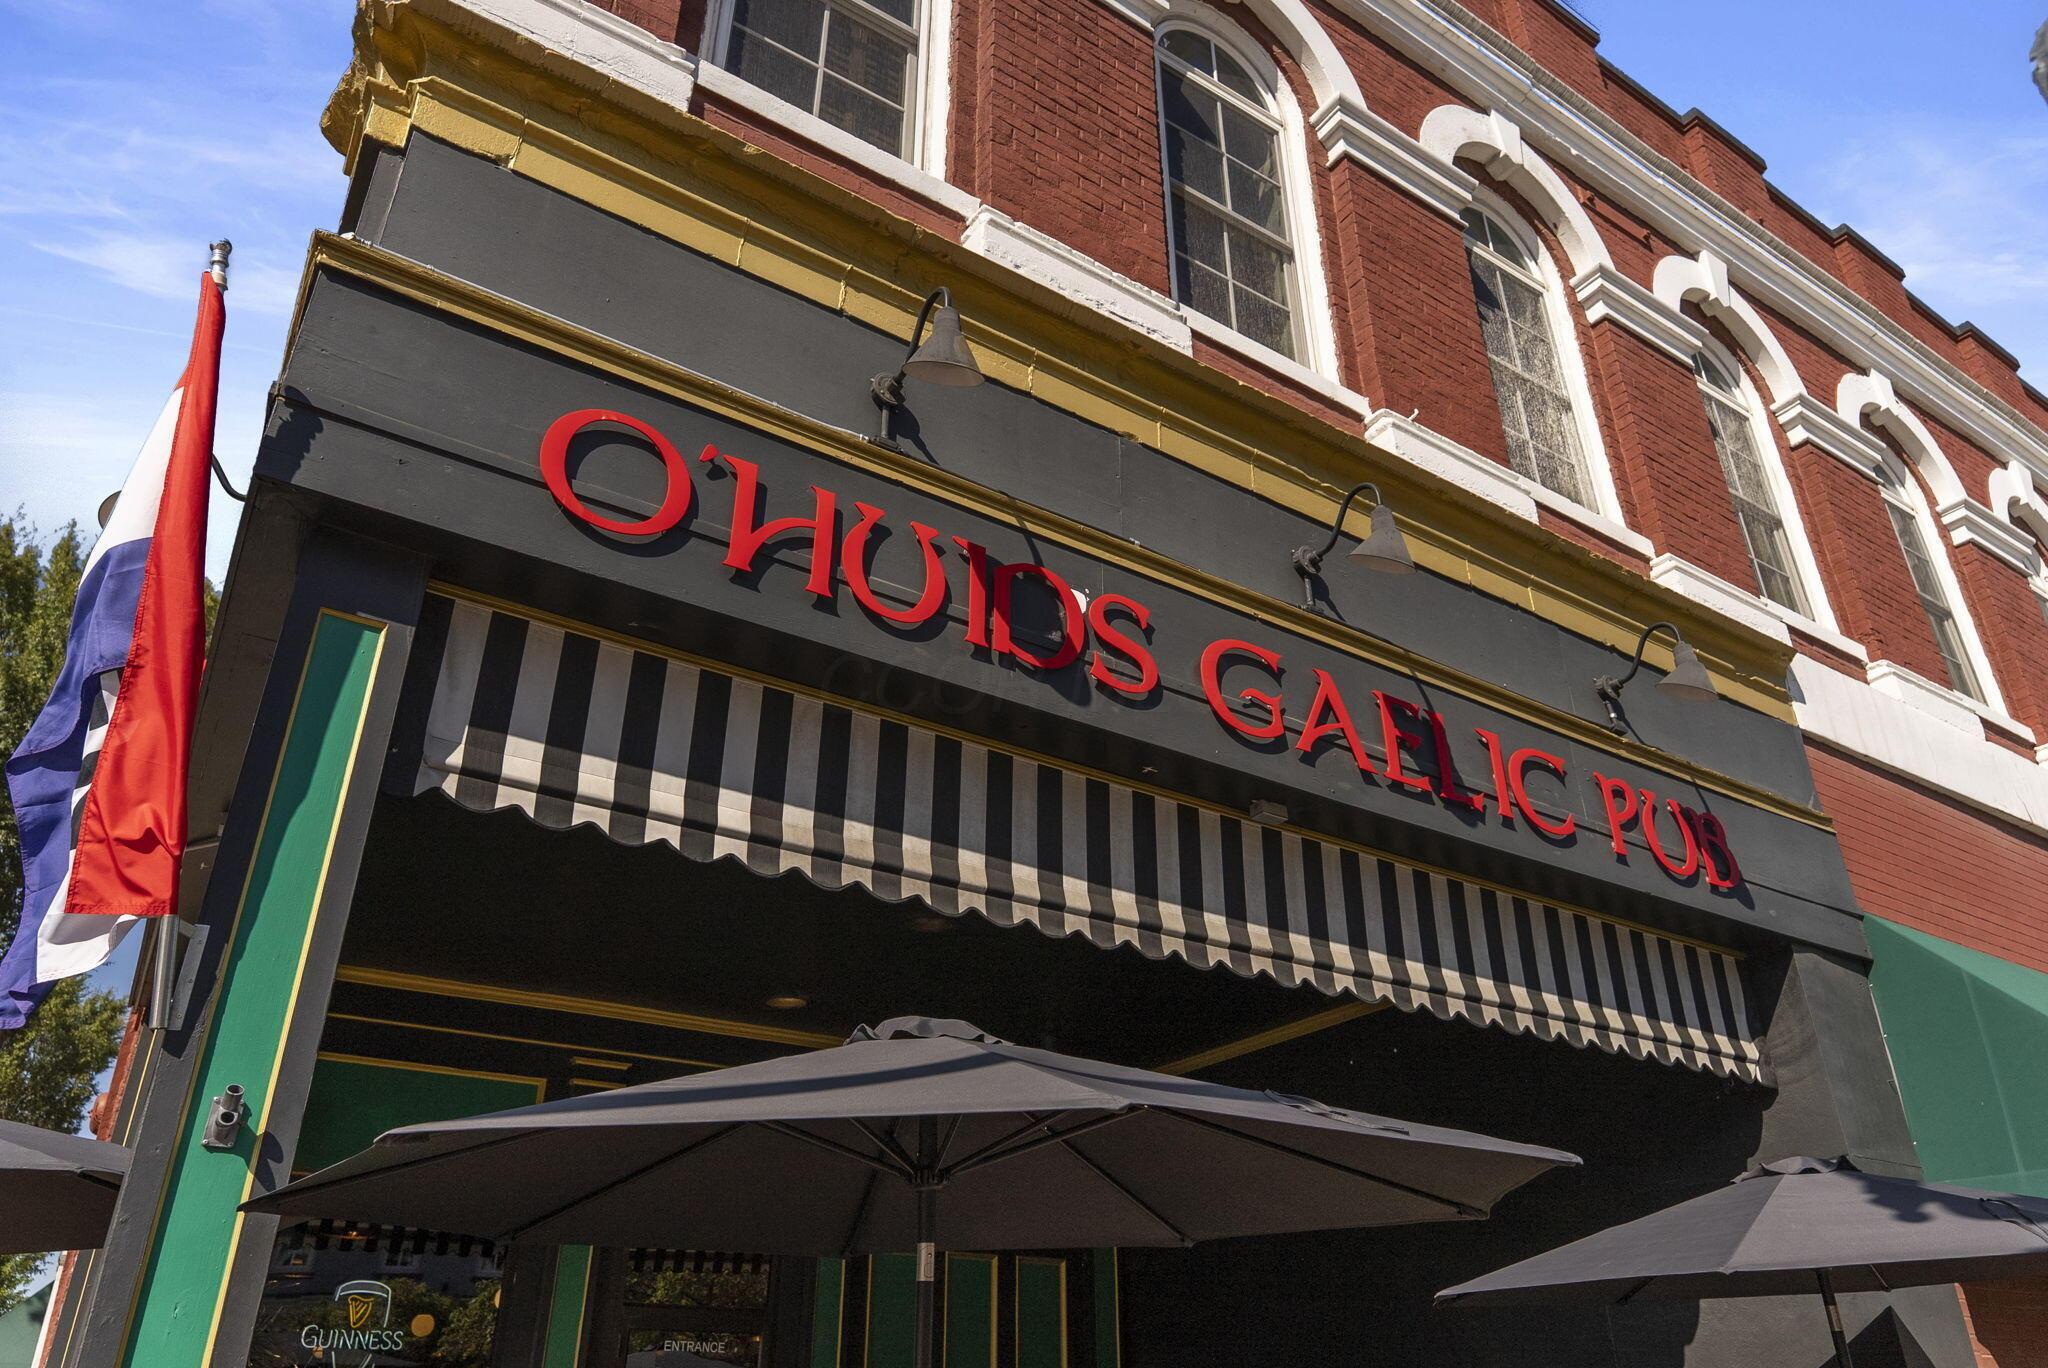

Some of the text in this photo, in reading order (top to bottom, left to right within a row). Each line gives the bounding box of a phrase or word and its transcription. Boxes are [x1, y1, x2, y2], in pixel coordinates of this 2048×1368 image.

[1200, 639, 1576, 837] GAELIC
[1593, 771, 1742, 888] PUB
[301, 1324, 404, 1350] GUINNESS
[663, 1340, 726, 1353] ENTRANCE
